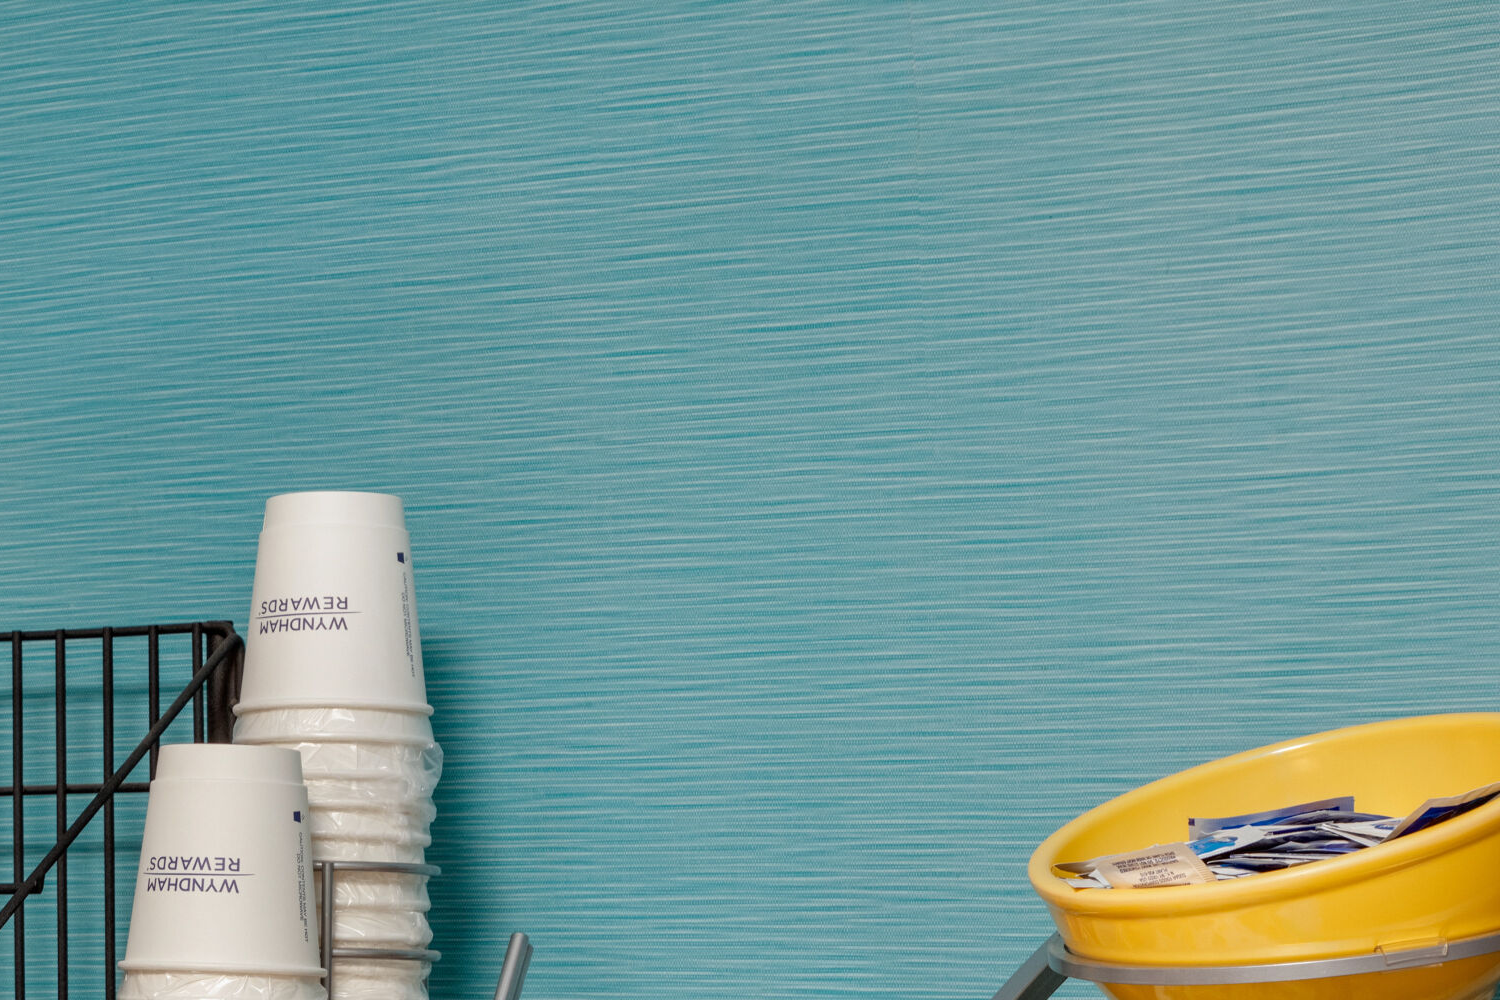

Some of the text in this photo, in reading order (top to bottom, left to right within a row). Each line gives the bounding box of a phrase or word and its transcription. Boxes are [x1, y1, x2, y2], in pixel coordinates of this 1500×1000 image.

[260, 596, 348, 615] REWARDS
[260, 617, 348, 635] WYNDHAM
[148, 856, 241, 872] REWARDS
[147, 878, 239, 893] WYNDHAM
